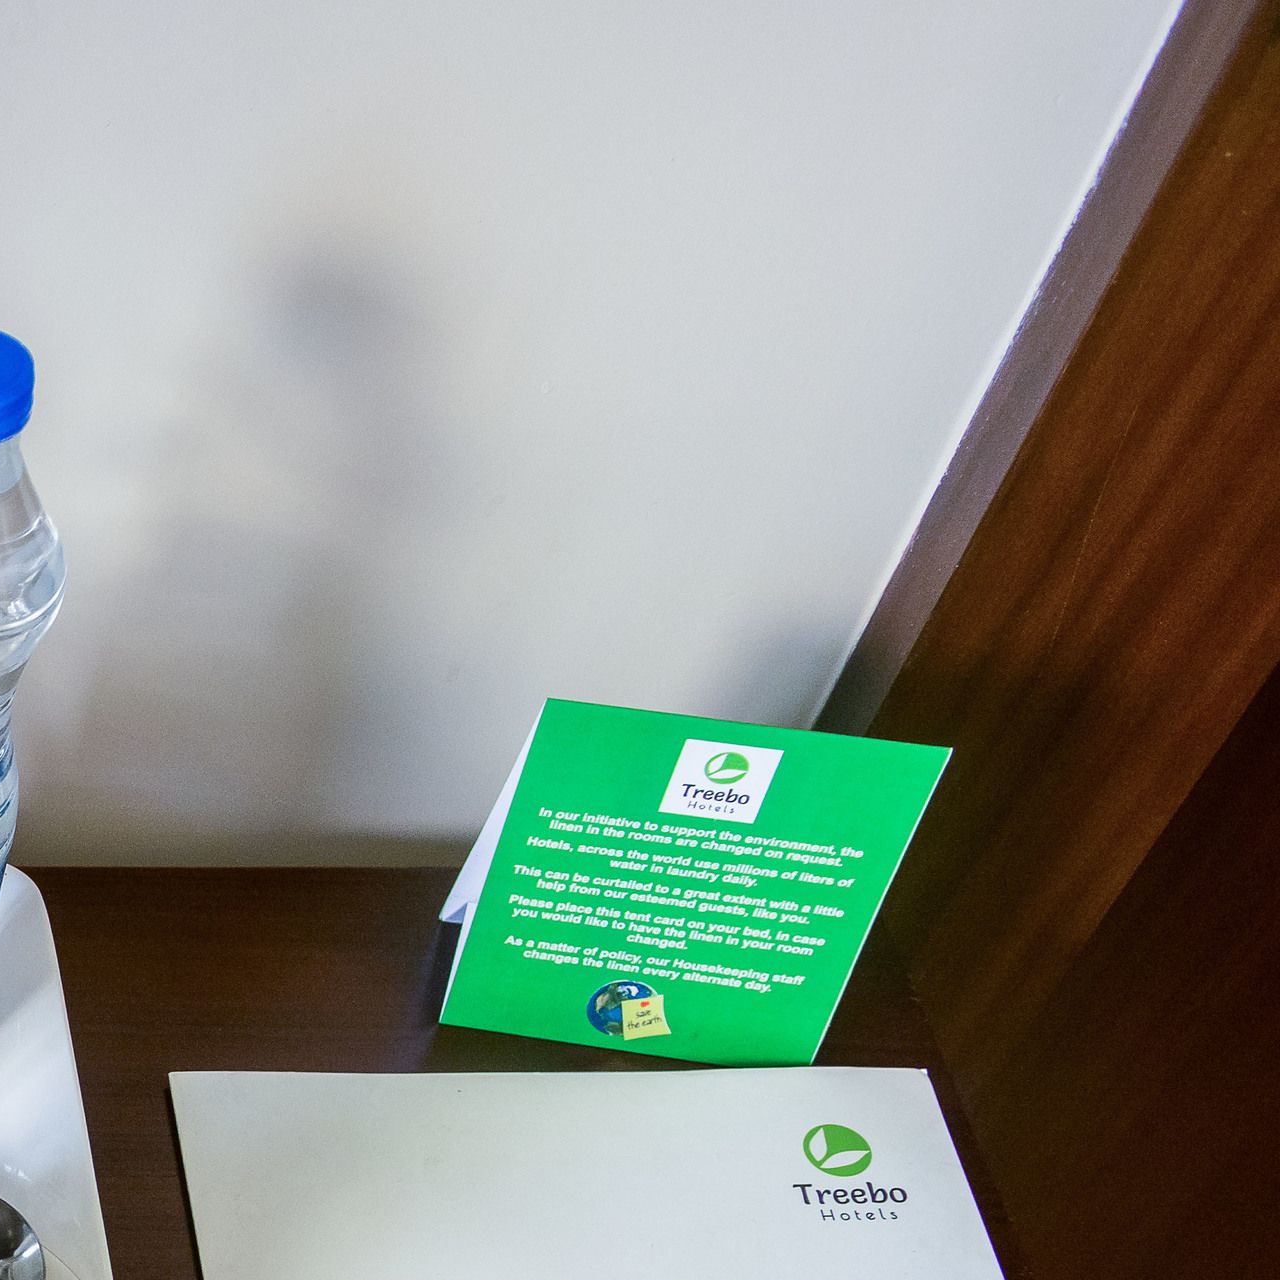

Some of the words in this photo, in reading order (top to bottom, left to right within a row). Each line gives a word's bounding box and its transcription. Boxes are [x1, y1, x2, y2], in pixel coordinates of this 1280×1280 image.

[682, 784, 750, 805] Treebo
[687, 801, 735, 814] Hotels
[539, 807, 552, 817] In
[555, 811, 580, 821] our
[582, 813, 641, 829] initiative
[644, 821, 658, 831] to
[661, 825, 717, 839] support
[719, 831, 742, 842] the
[840, 847, 864, 858] the
[549, 819, 583, 832] linen
[586, 824, 600, 834] in
[603, 827, 625, 838] the
[627, 832, 672, 844] rooms
[675, 838, 698, 847] are
[701, 840, 763, 856] changed
[764, 850, 784, 859] on
[527, 836, 573, 852] Hotels,
[577, 845, 624, 857] across
[627, 850, 649, 860] the
[652, 855, 692, 866] world
[694, 860, 720, 870] use
[722, 864, 778, 878] millions
[781, 871, 798, 880] of
[798, 872, 834, 885] liters
[837, 879, 855, 887] of
[610, 860, 648, 871] water
[650, 863, 664, 873] in
[666, 866, 720, 883] laundry
[509, 894, 554, 909] Please
[556, 902, 593, 914] place
[596, 907, 621, 918] this
[624, 911, 651, 922] tent
[653, 916, 685, 927] card
[687, 921, 705, 930] on
[707, 923, 741, 934] your
[775, 931, 790, 941] in
[792, 935, 826, 946] case
[504, 935, 523, 946] As
[537, 941, 581, 953] matter
[583, 947, 599, 956] of
[646, 957, 671, 966] our
[672, 959, 770, 982] Housekeeping
[772, 974, 805, 985] staff
[523, 950, 579, 964] changes
[583, 957, 604, 968] the
[607, 960, 640, 973] linen
[642, 967, 680, 980] every
[682, 972, 742, 987] alternate
[792, 1182, 907, 1205] Treebo
[820, 1208, 898, 1221] Hotels
